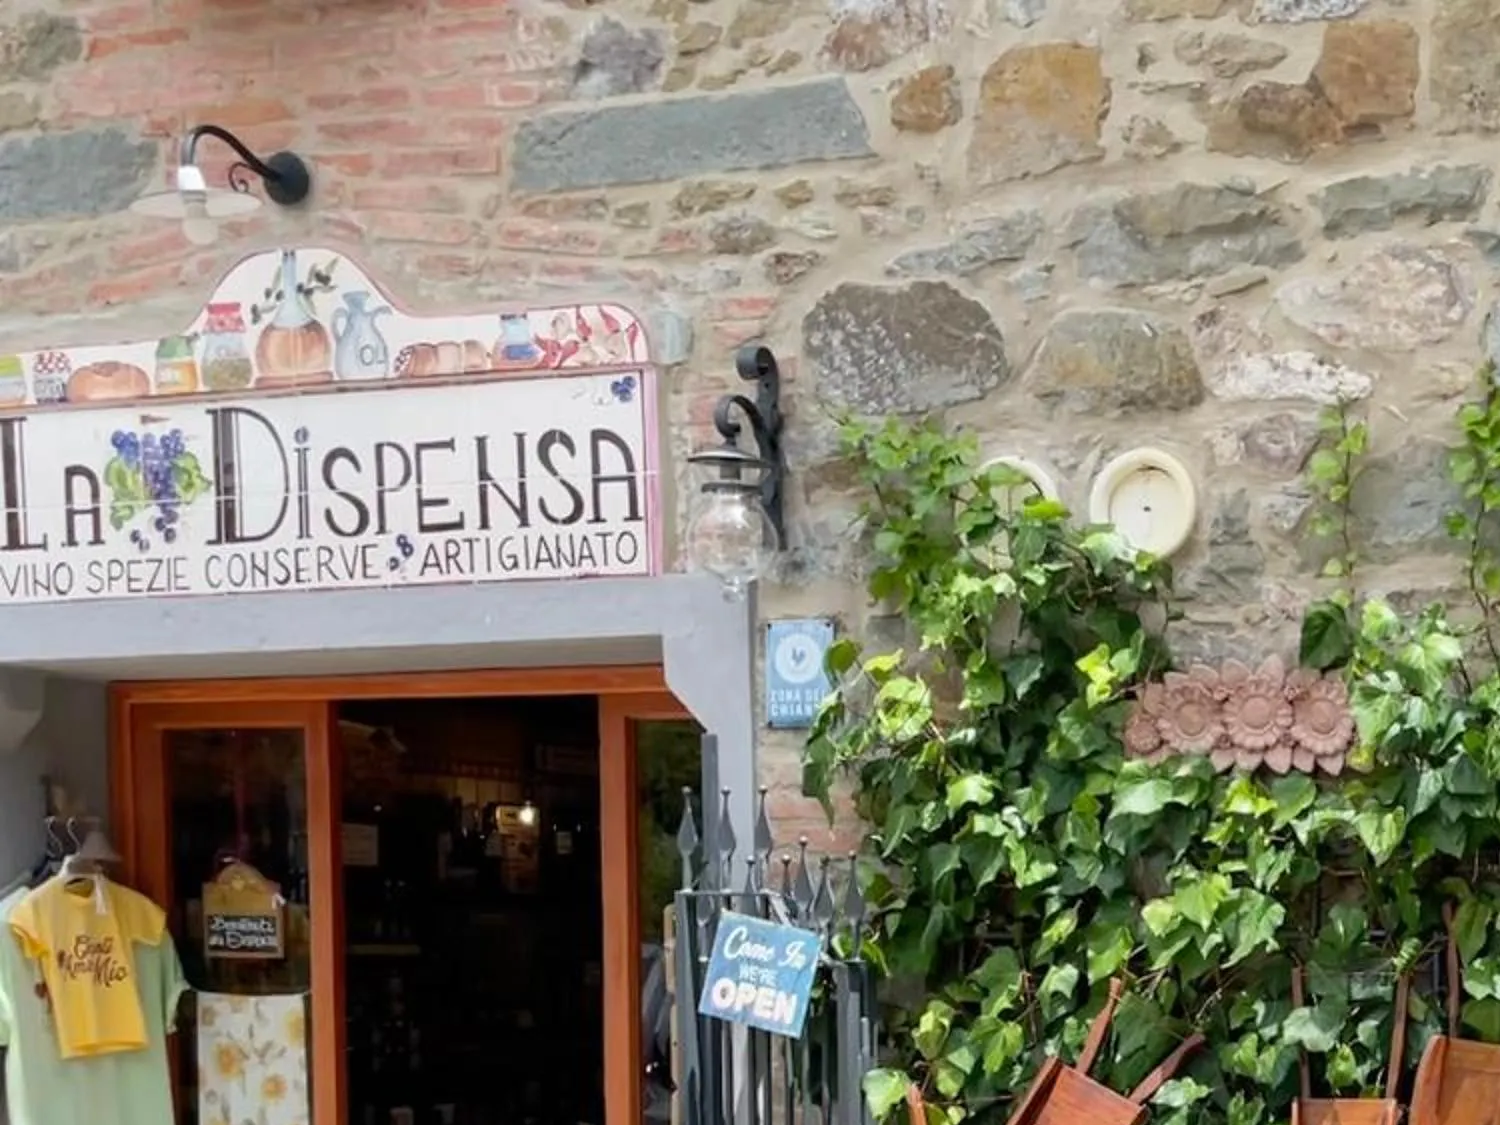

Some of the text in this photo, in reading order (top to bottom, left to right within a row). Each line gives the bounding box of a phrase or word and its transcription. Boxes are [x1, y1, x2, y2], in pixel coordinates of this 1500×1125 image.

[0, 416, 106, 551] LA
[0, 531, 639, 598] VINO SPEZIE CONSERVE ARTIGIANATO
[723, 925, 776, 962] Come
[711, 977, 798, 1025] OPEN
